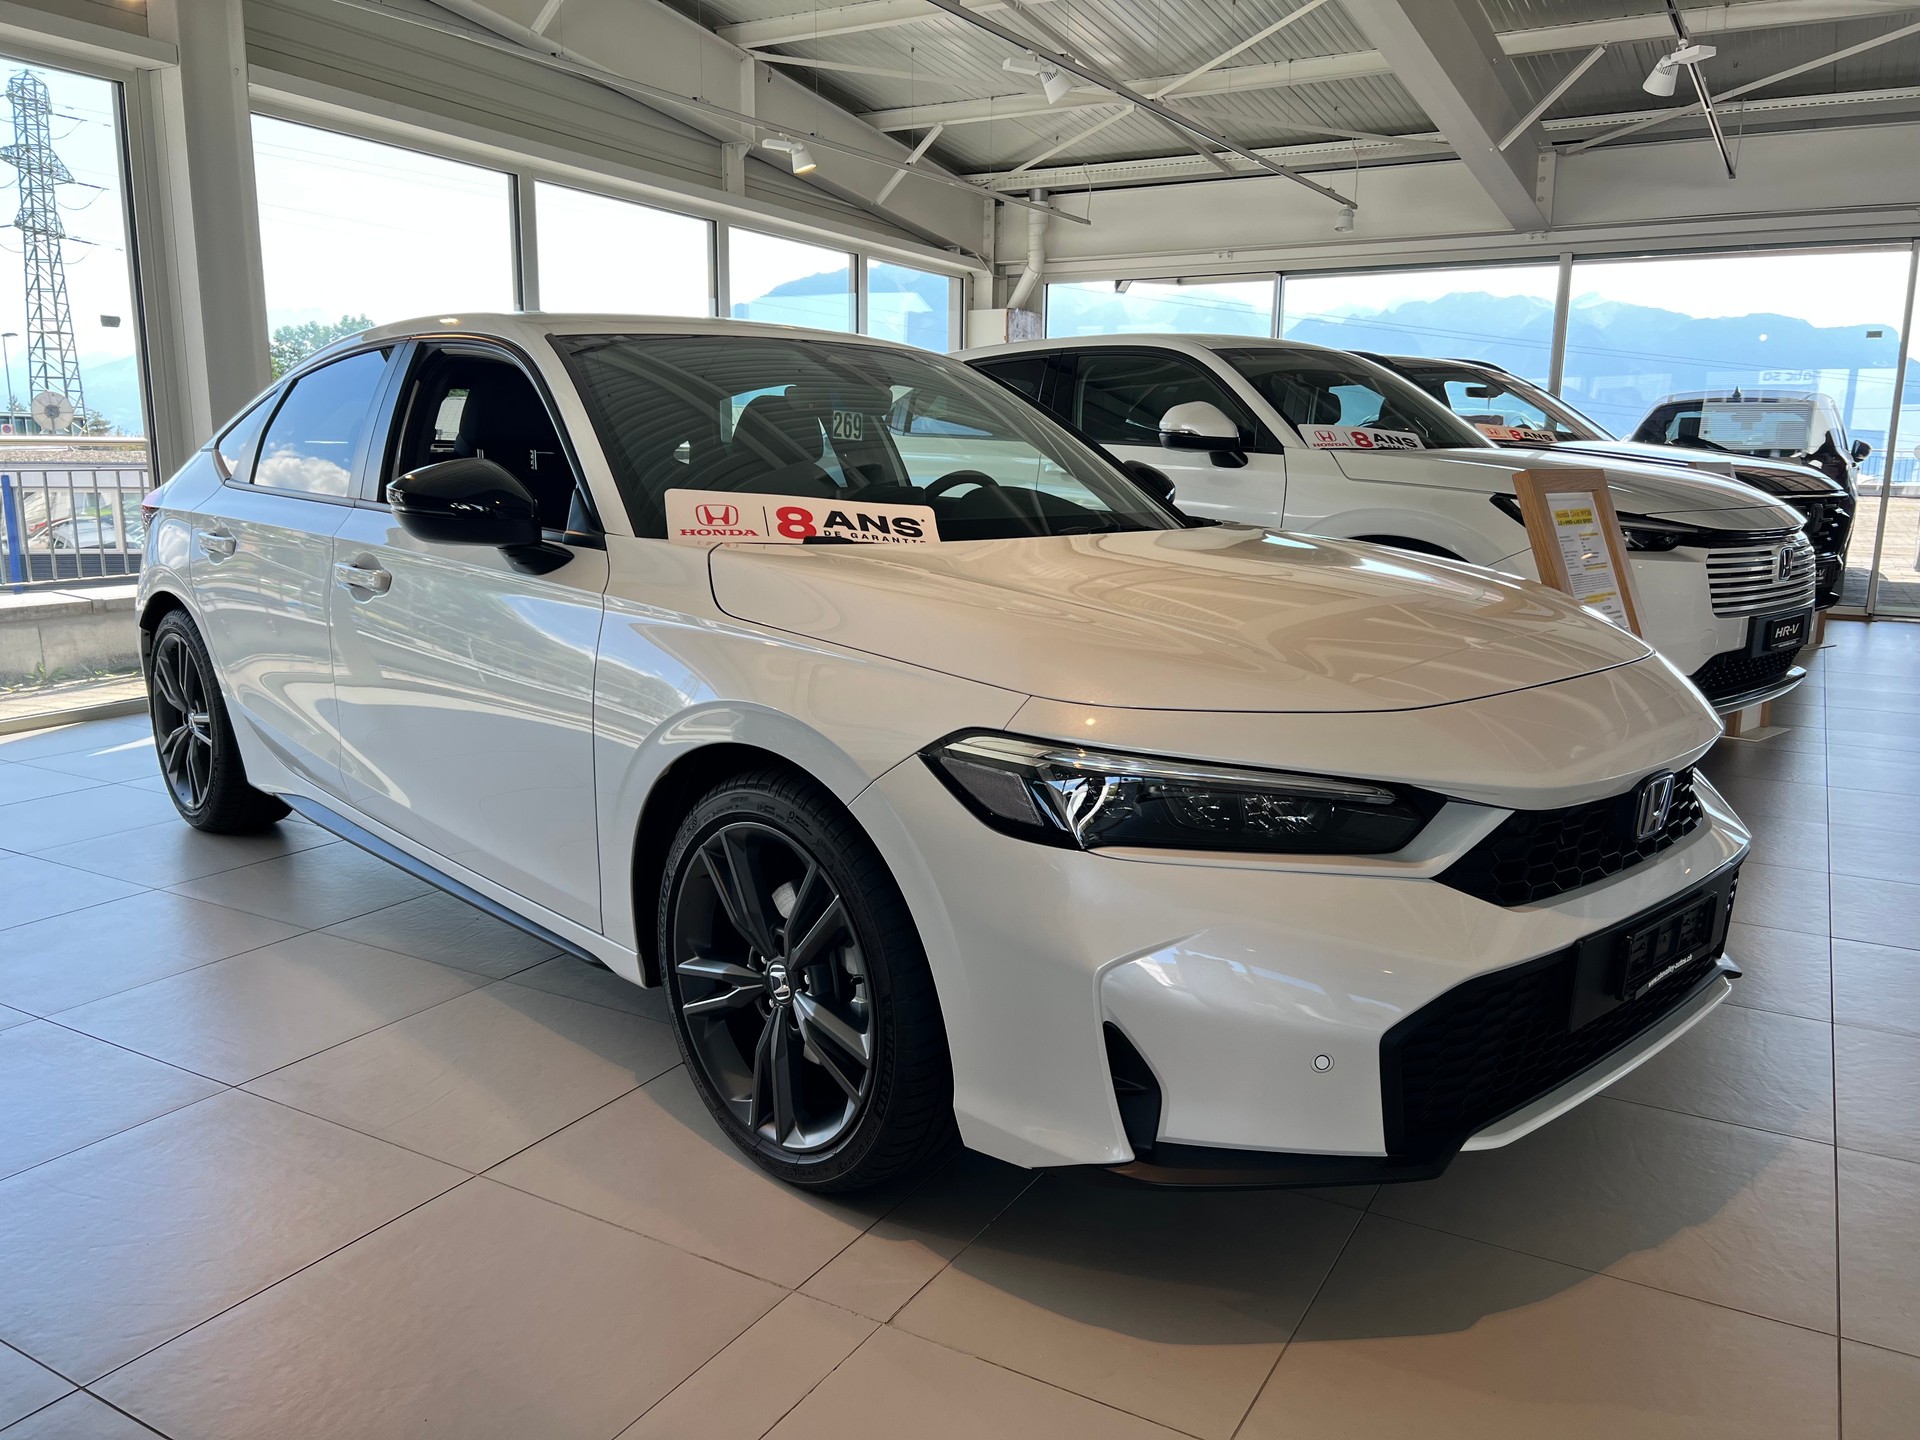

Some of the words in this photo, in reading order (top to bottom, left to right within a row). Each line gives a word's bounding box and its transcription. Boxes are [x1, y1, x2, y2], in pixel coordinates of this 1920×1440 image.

[833, 411, 862, 440] 269
[1350, 431, 1374, 448] 8
[1374, 433, 1418, 448] ANS
[1509, 429, 1523, 440] 8
[776, 506, 817, 539] 8
[823, 510, 924, 538] ANS
[680, 528, 759, 537] HONDA
[824, 530, 841, 538] DE
[850, 532, 926, 544] GARANT
[1774, 622, 1800, 639] HR-V
